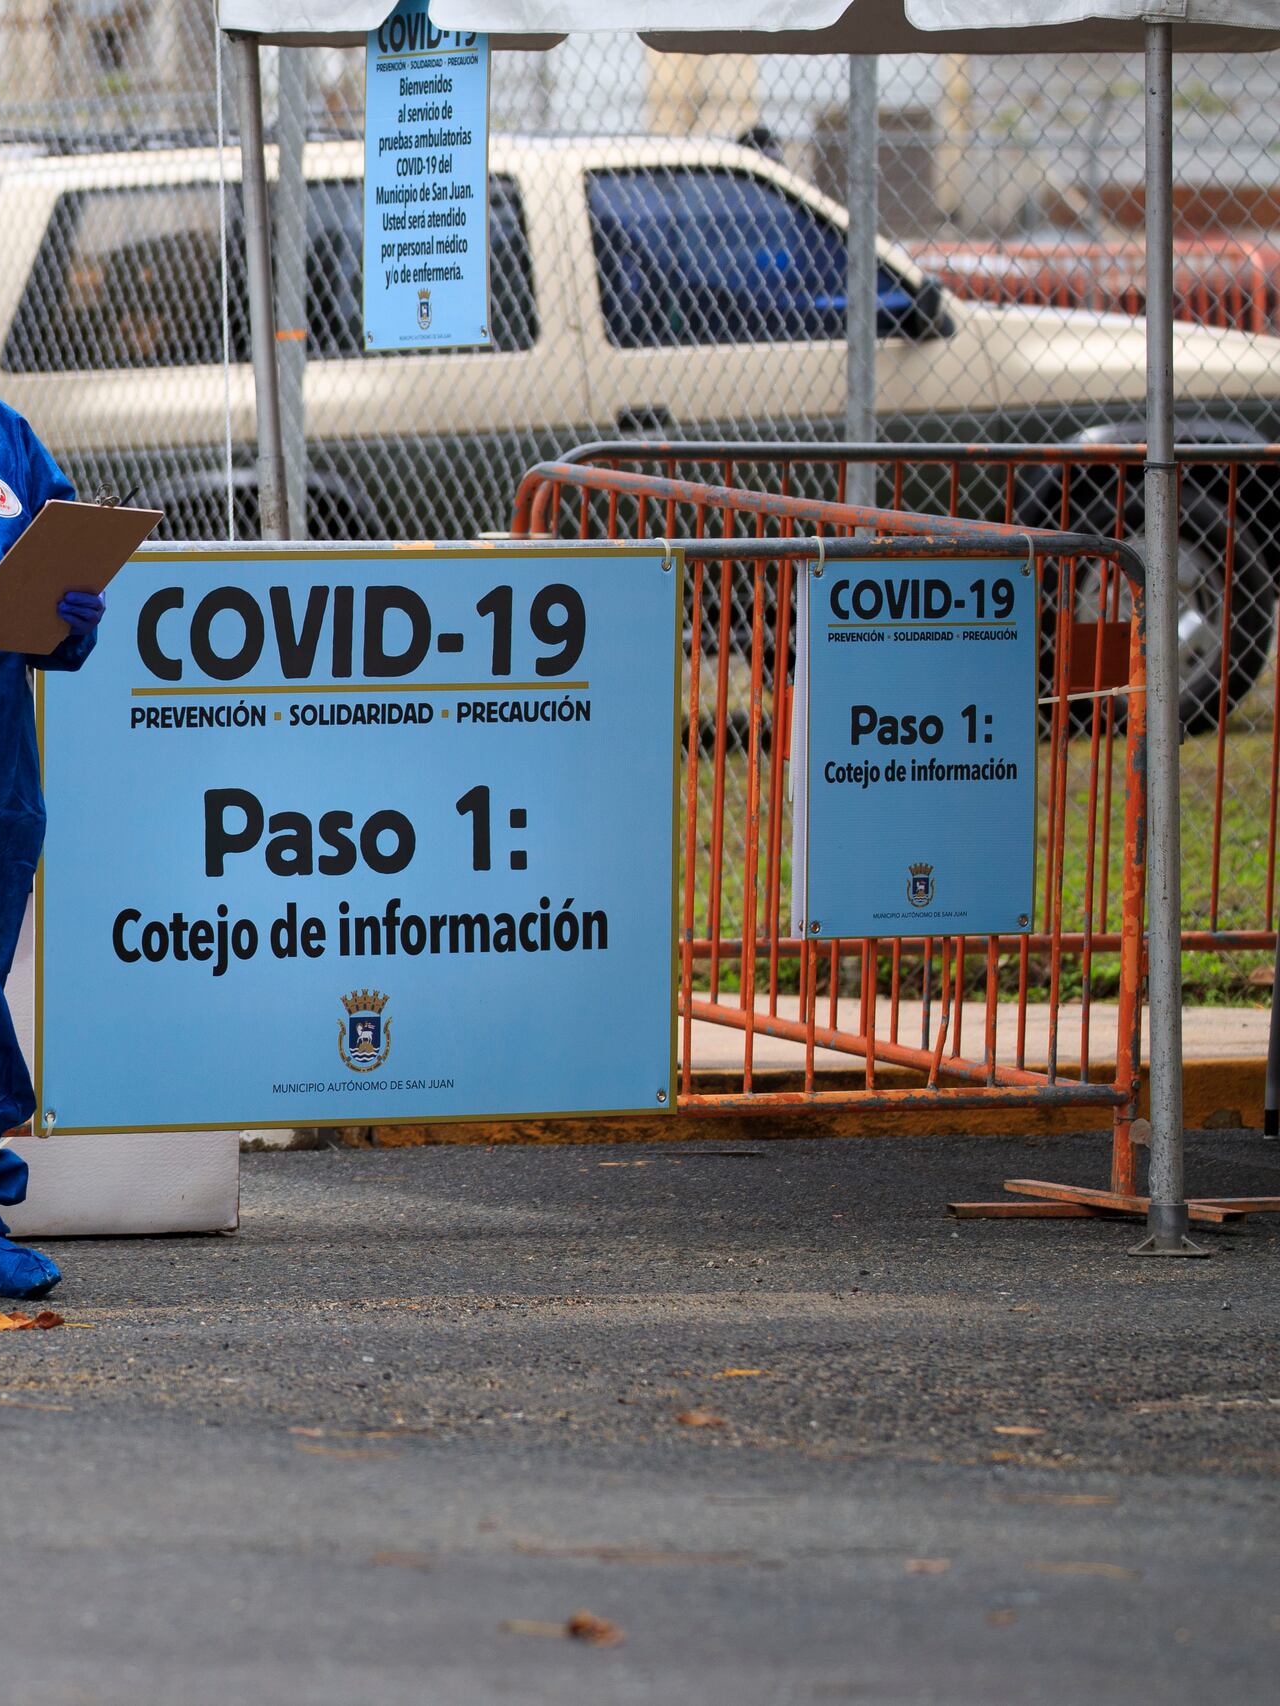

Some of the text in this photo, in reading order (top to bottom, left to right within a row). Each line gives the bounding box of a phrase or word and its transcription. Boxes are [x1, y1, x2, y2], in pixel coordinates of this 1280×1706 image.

[377, 54, 478, 72] PREVENCIÓN SOLIDARIDAD PRECAUCIÓN
[400, 76, 452, 96] Bienvenidos
[398, 102, 452, 123] al servicio de
[379, 128, 471, 156] pruebas ambulatorias
[397, 154, 452, 176] COVID-19 del
[376, 182, 473, 208] Municipio de San Juan.
[383, 209, 466, 231] Usted será atendido
[382, 236, 467, 263] por personal médico
[386, 262, 463, 289] y/o de enfermería.
[830, 578, 1014, 620] COVID-19
[137, 584, 587, 681] COVID-19
[828, 628, 1017, 642] PREVENCIÓN SOLIDARIDAD PRECAUCIÓN
[131, 695, 590, 728] PREVENCIÓN SOLIDARIDAD PRECAUCIÓN
[851, 704, 992, 745] Paso 1:
[825, 758, 1017, 789] Cotejo de información
[204, 785, 527, 877] Paso 1:
[113, 896, 608, 976] Cotejo de información
[273, 1079, 454, 1093] MUNICIPIO AUTÓNOMO DE SAN JUAN
